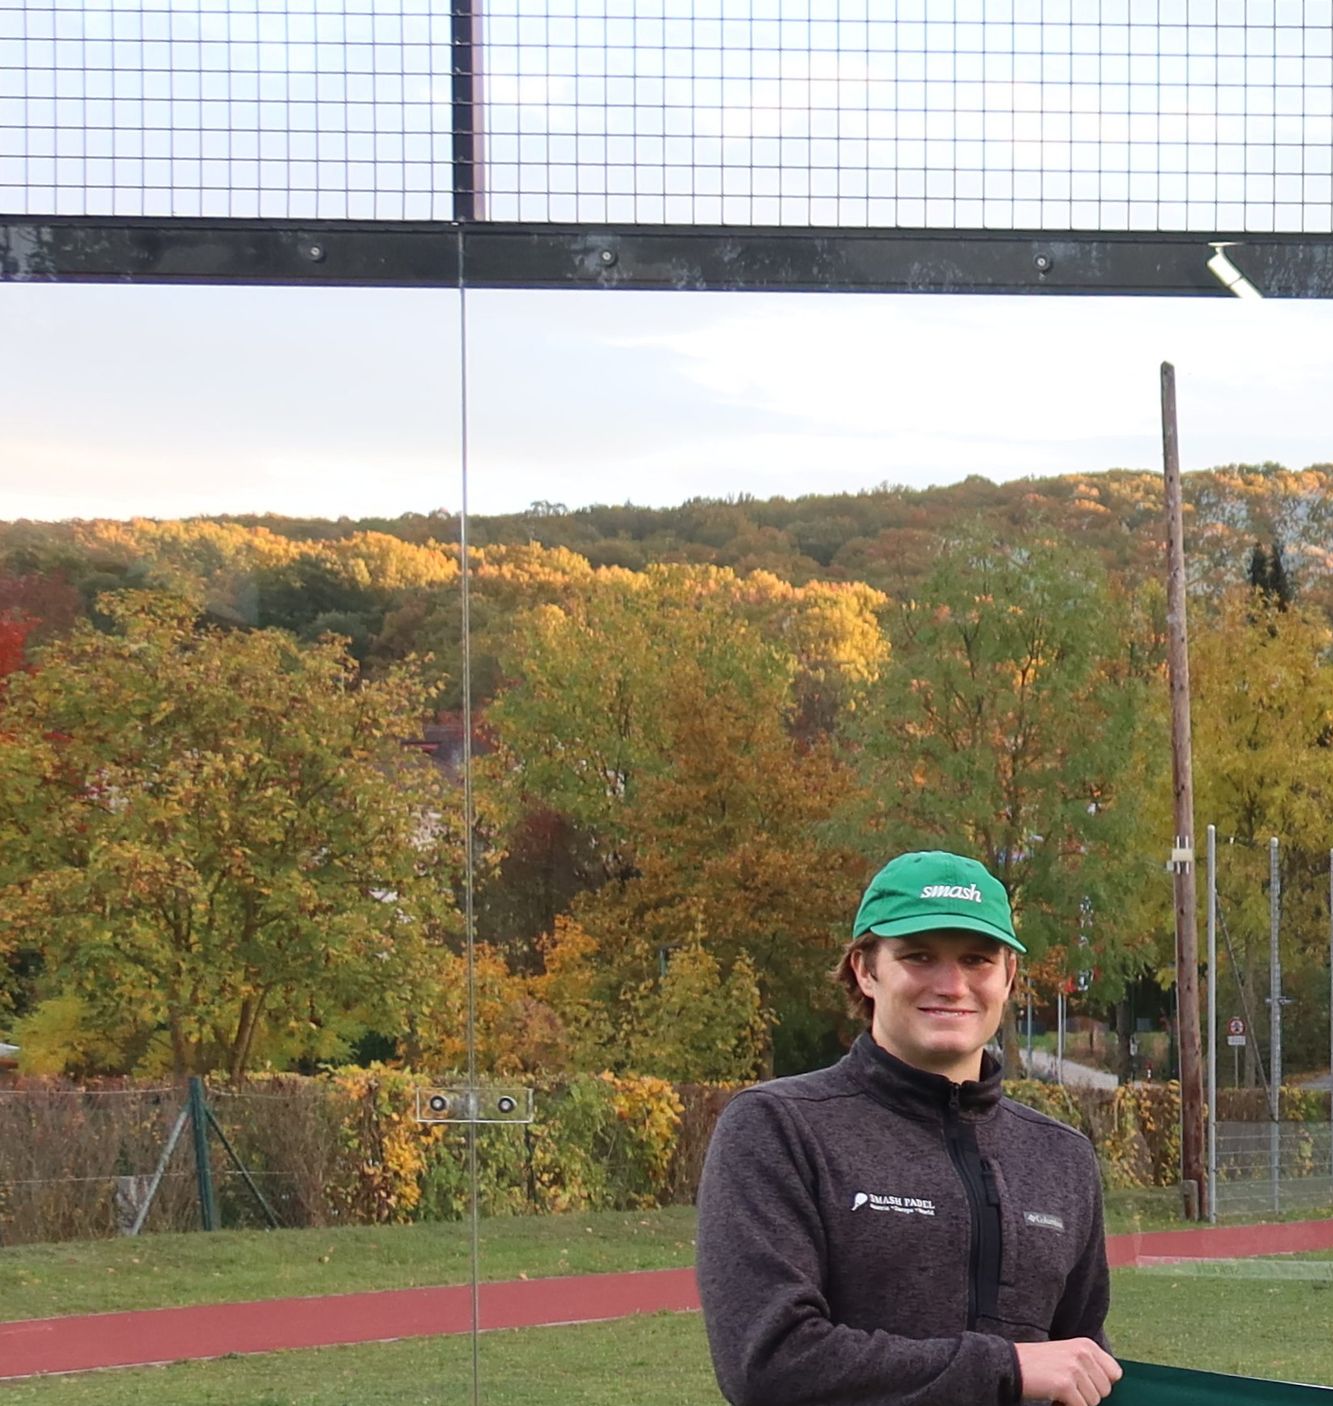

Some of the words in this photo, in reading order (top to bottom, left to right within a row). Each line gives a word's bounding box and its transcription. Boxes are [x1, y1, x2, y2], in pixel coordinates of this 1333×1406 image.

[920, 883, 982, 903] smash
[869, 1193, 903, 1207] SMASH
[903, 1197, 936, 1210] PADEL
